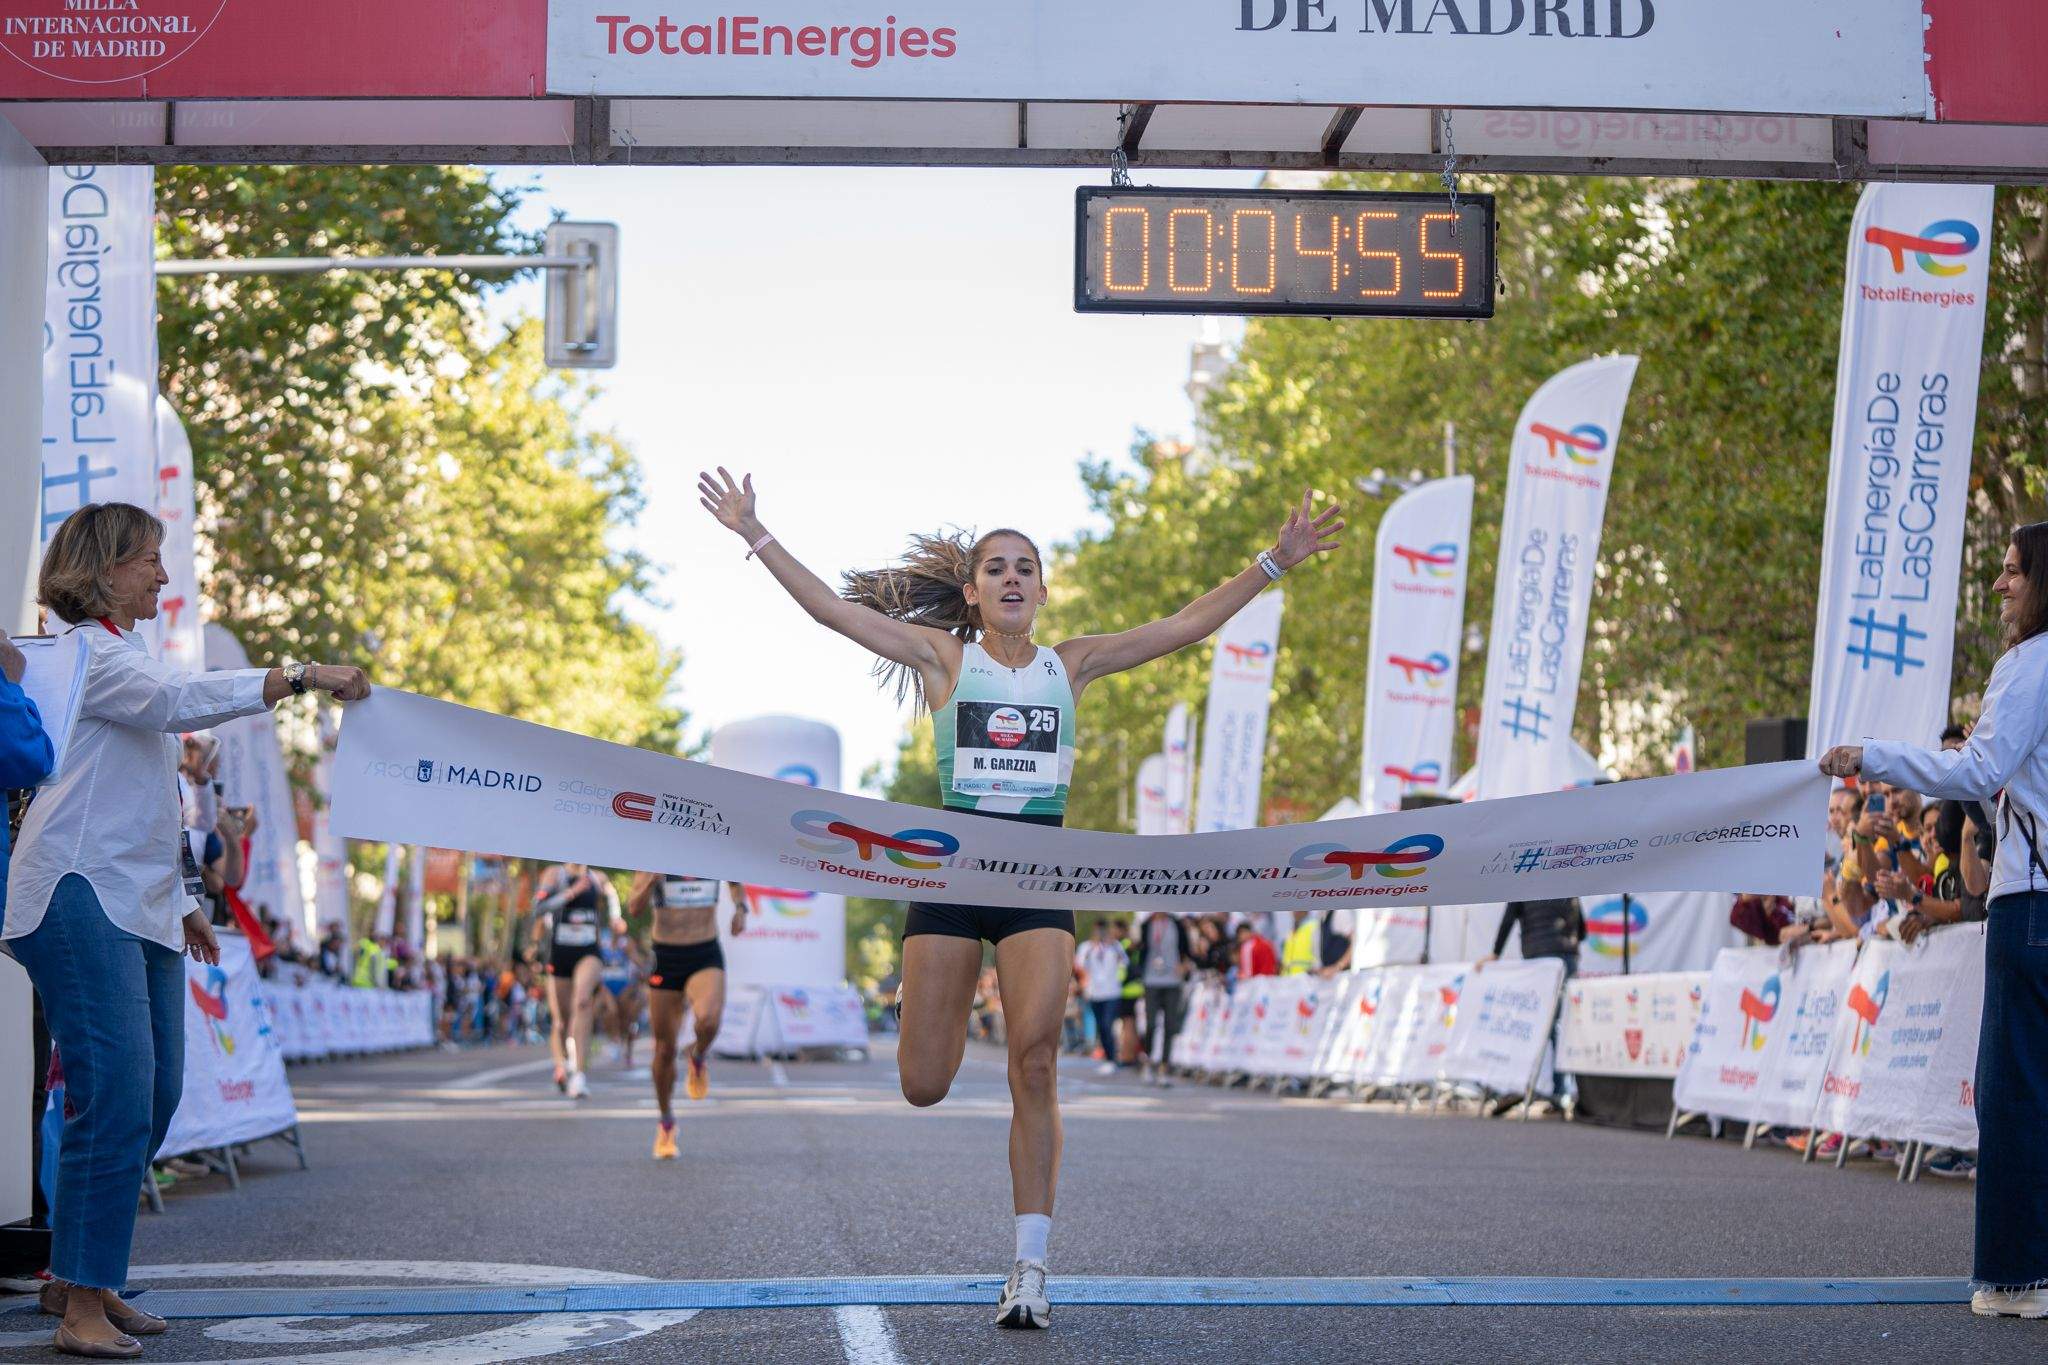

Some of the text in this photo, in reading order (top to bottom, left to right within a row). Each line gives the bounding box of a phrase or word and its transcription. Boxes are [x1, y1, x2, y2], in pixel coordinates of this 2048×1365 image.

[1235, 0, 1656, 39] DE MADRID
[32, 39, 167, 59] DE MADRID
[596, 15, 958, 69] TotalEnergies
[1105, 207, 1463, 298] 00:04:55
[1861, 285, 1975, 308] TotalEnergies
[1891, 373, 1949, 601] LasCarreras
[1029, 708, 1056, 733] 25
[973, 756, 1037, 773] M. GARZZIA
[447, 764, 542, 793] MADRID
[661, 799, 724, 822] MILLA
[662, 793, 713, 809] new balance
[656, 811, 733, 836] URBANA
[1543, 851, 1634, 871] LasCarreras
[817, 859, 947, 889] TotalEnergies
[1099, 883, 1211, 896] MADRID
[1310, 884, 1429, 898] TotalEnergies
